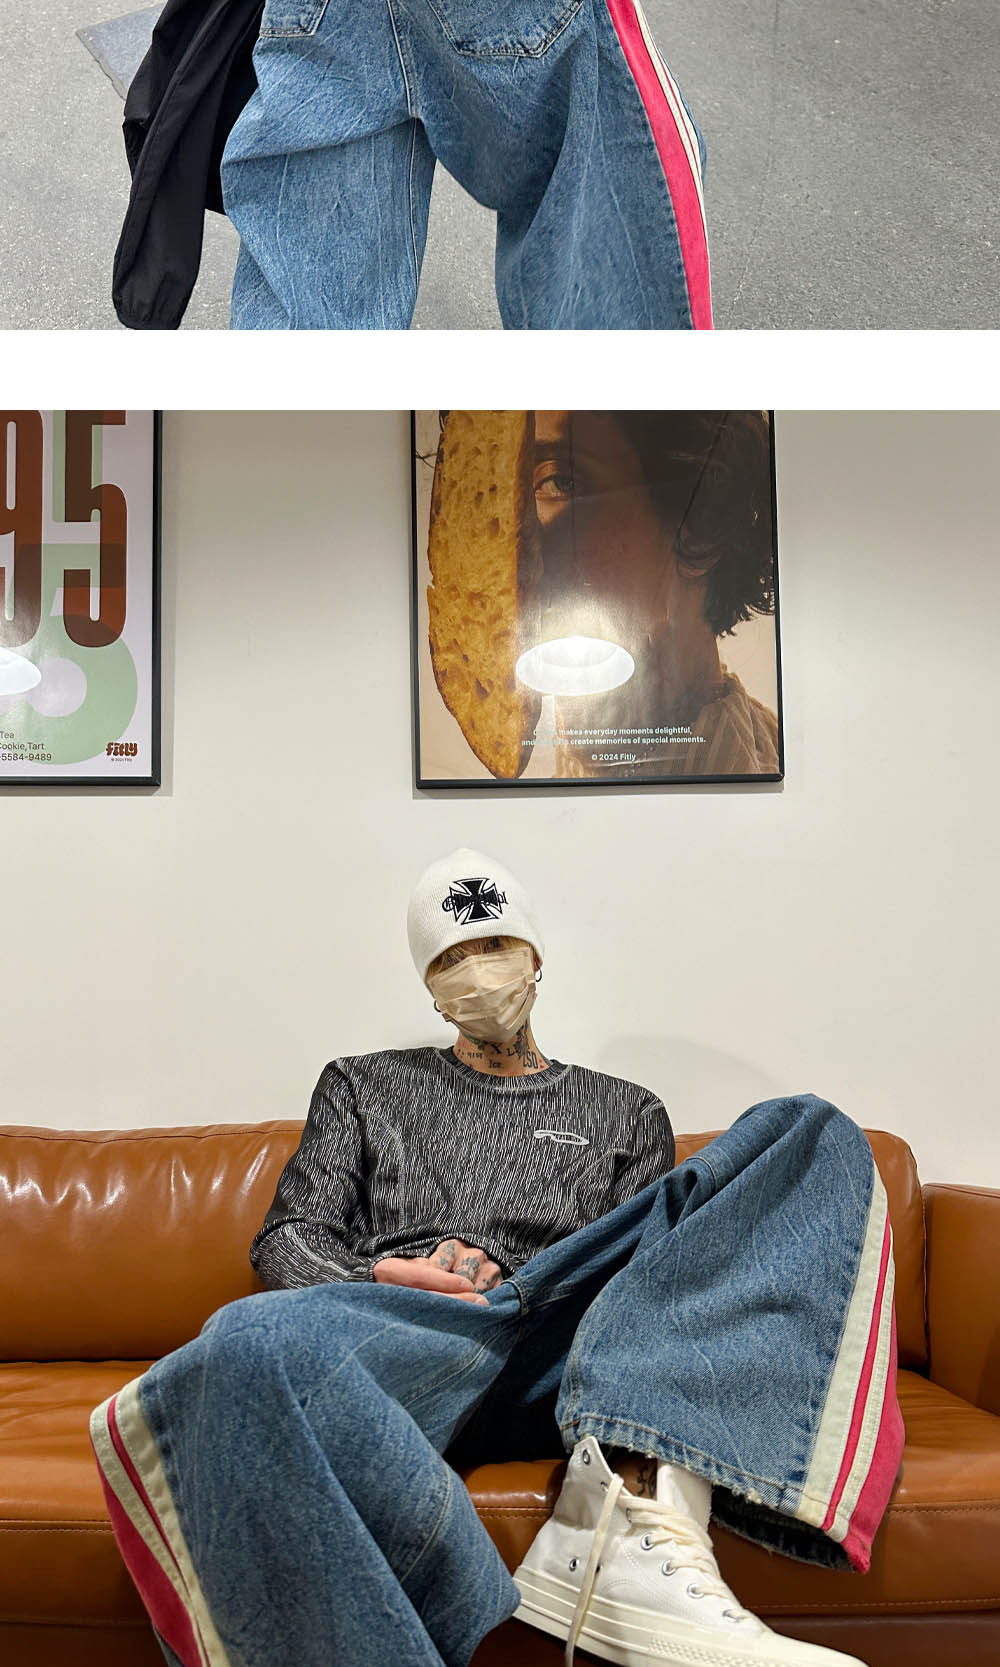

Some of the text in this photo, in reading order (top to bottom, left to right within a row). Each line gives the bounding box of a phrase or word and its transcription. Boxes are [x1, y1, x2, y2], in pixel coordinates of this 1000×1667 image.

[584, 728, 617, 736] everyday
[619, 727, 653, 735] moments
[655, 726, 692, 735] delightful,
[633, 736, 641, 744] of
[642, 736, 668, 745] special
[670, 735, 706, 744] moments.
[599, 753, 619, 761] 2024
[620, 753, 636, 762] Fitly
